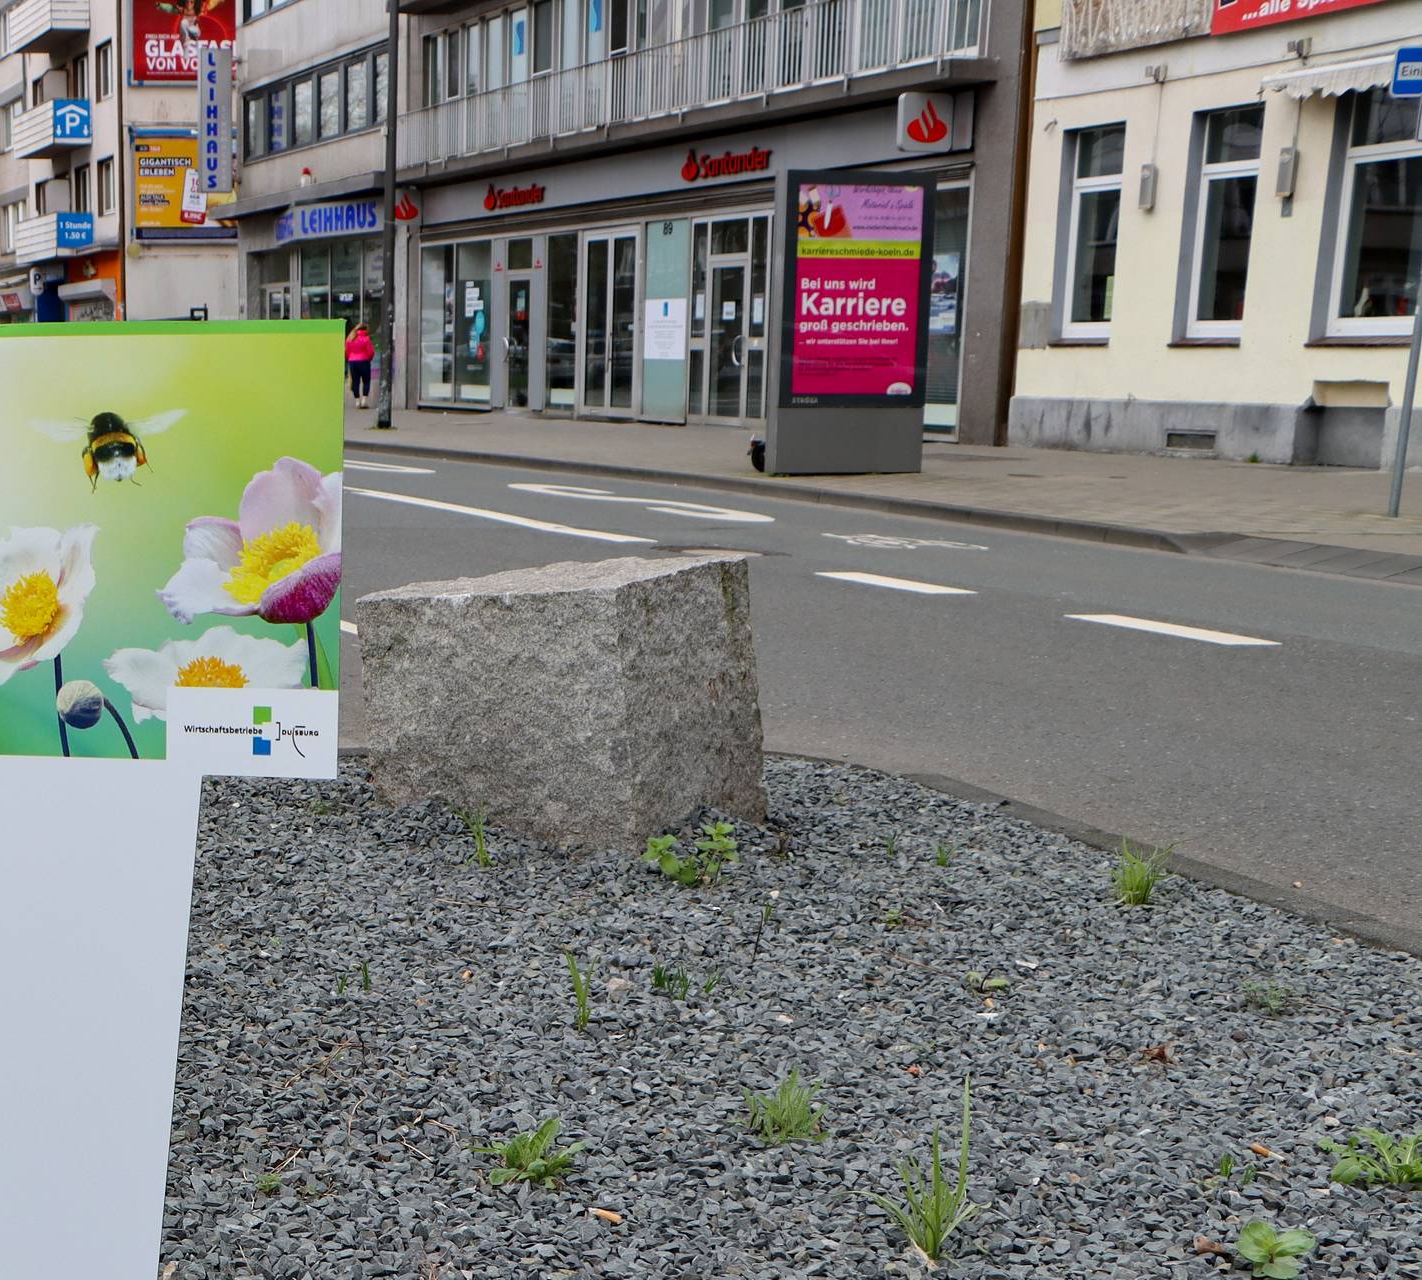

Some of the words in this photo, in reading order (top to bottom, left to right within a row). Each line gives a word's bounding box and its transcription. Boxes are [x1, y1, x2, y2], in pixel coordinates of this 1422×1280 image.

[146, 58, 176, 70] VON
[1401, 64, 1422, 77] Ein
[65, 112, 80, 135] P
[207, 52, 218, 189] LEIHHAUS
[139, 158, 192, 167] GIGANTISCH
[700, 147, 772, 178] Santander
[139, 167, 175, 176] ERLEBEN
[496, 183, 546, 208] Santander
[300, 201, 377, 235] LEIHHAUS
[65, 221, 91, 229] Stunde
[663, 222, 673, 235] 89
[801, 247, 915, 257] karriereschmiede-koeln.de
[801, 278, 821, 290] Bei
[824, 280, 845, 290] uns
[849, 278, 876, 290] wird
[801, 292, 907, 316] Karriere
[800, 319, 828, 333] groß
[831, 320, 909, 333] geschrieben.
[183, 725, 263, 735] Wirtschaftsbetriebe
